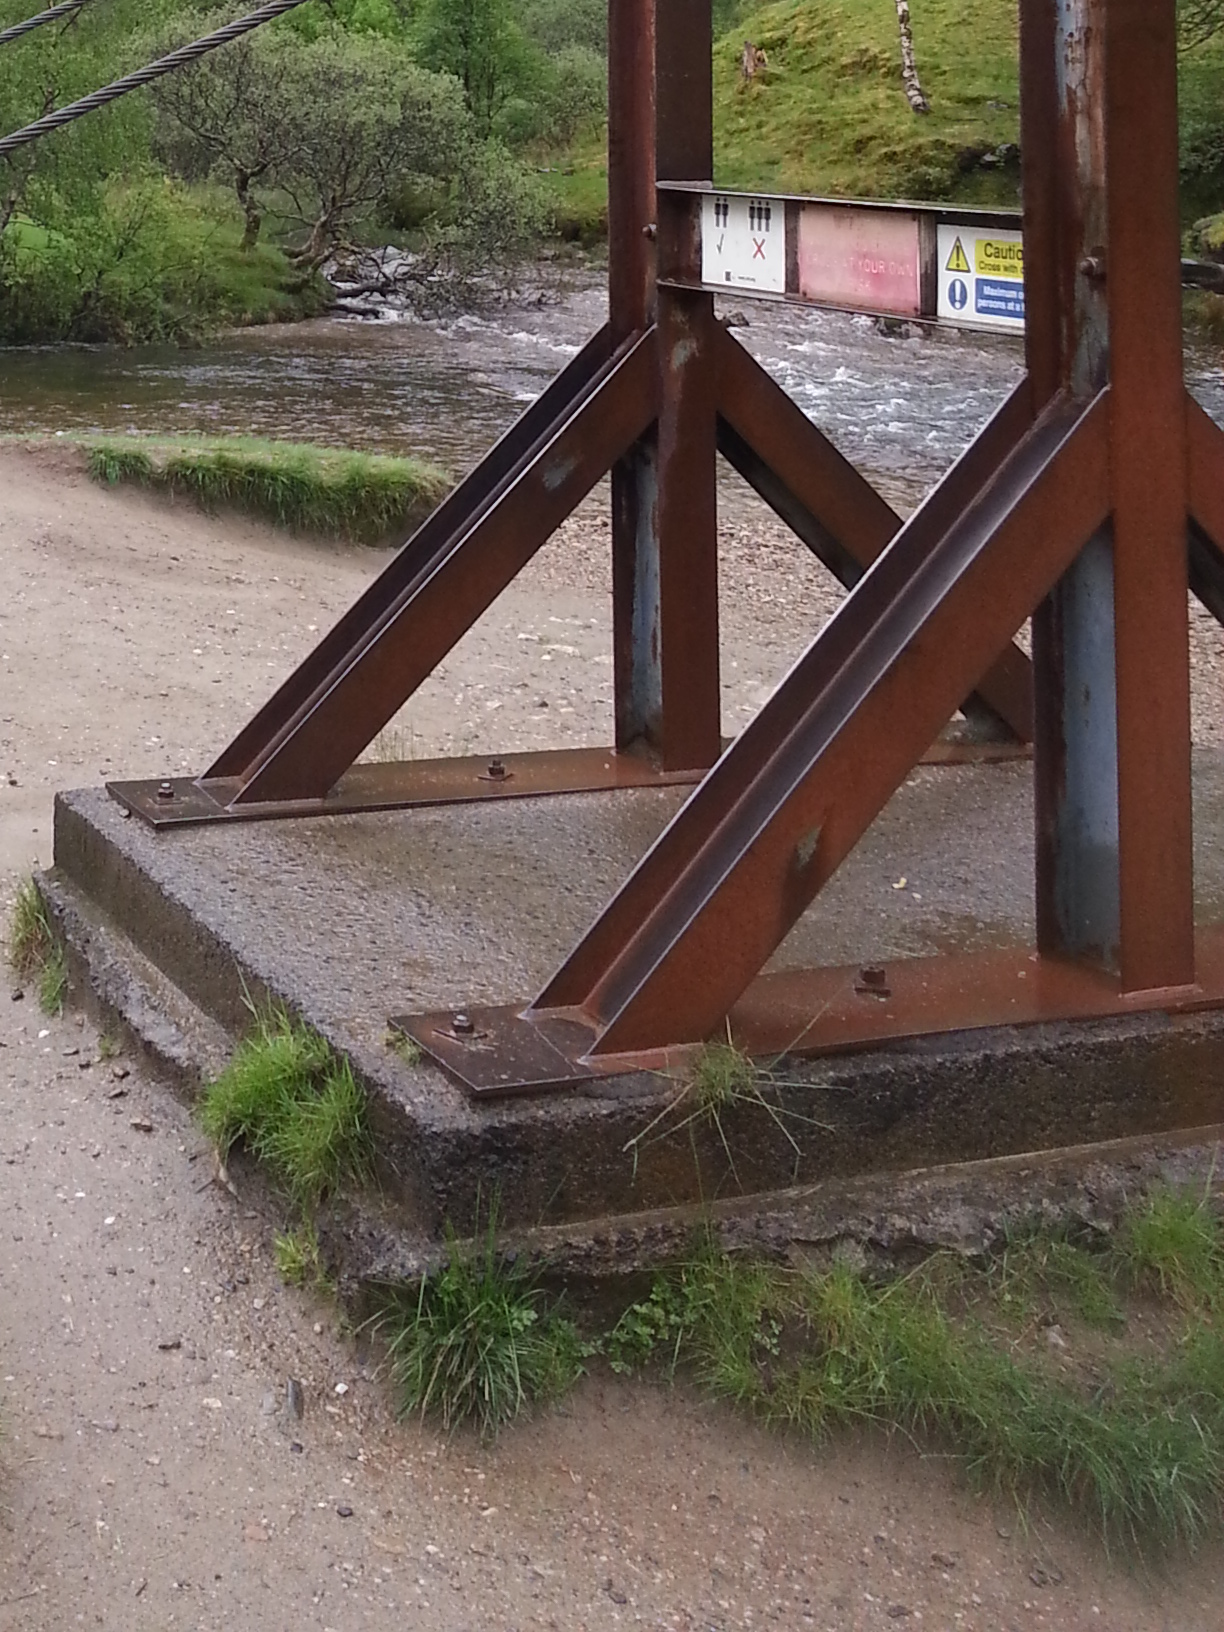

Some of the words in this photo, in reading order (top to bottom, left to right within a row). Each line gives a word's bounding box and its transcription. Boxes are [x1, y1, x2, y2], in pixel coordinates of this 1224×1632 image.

[984, 242, 1024, 260] Cautio
[858, 258, 885, 274] YOUR
[979, 260, 1001, 272] Cross
[1003, 262, 1018, 274] with
[982, 285, 1017, 299] Maximum
[977, 298, 1006, 311] persons
[1007, 300, 1015, 311] at
